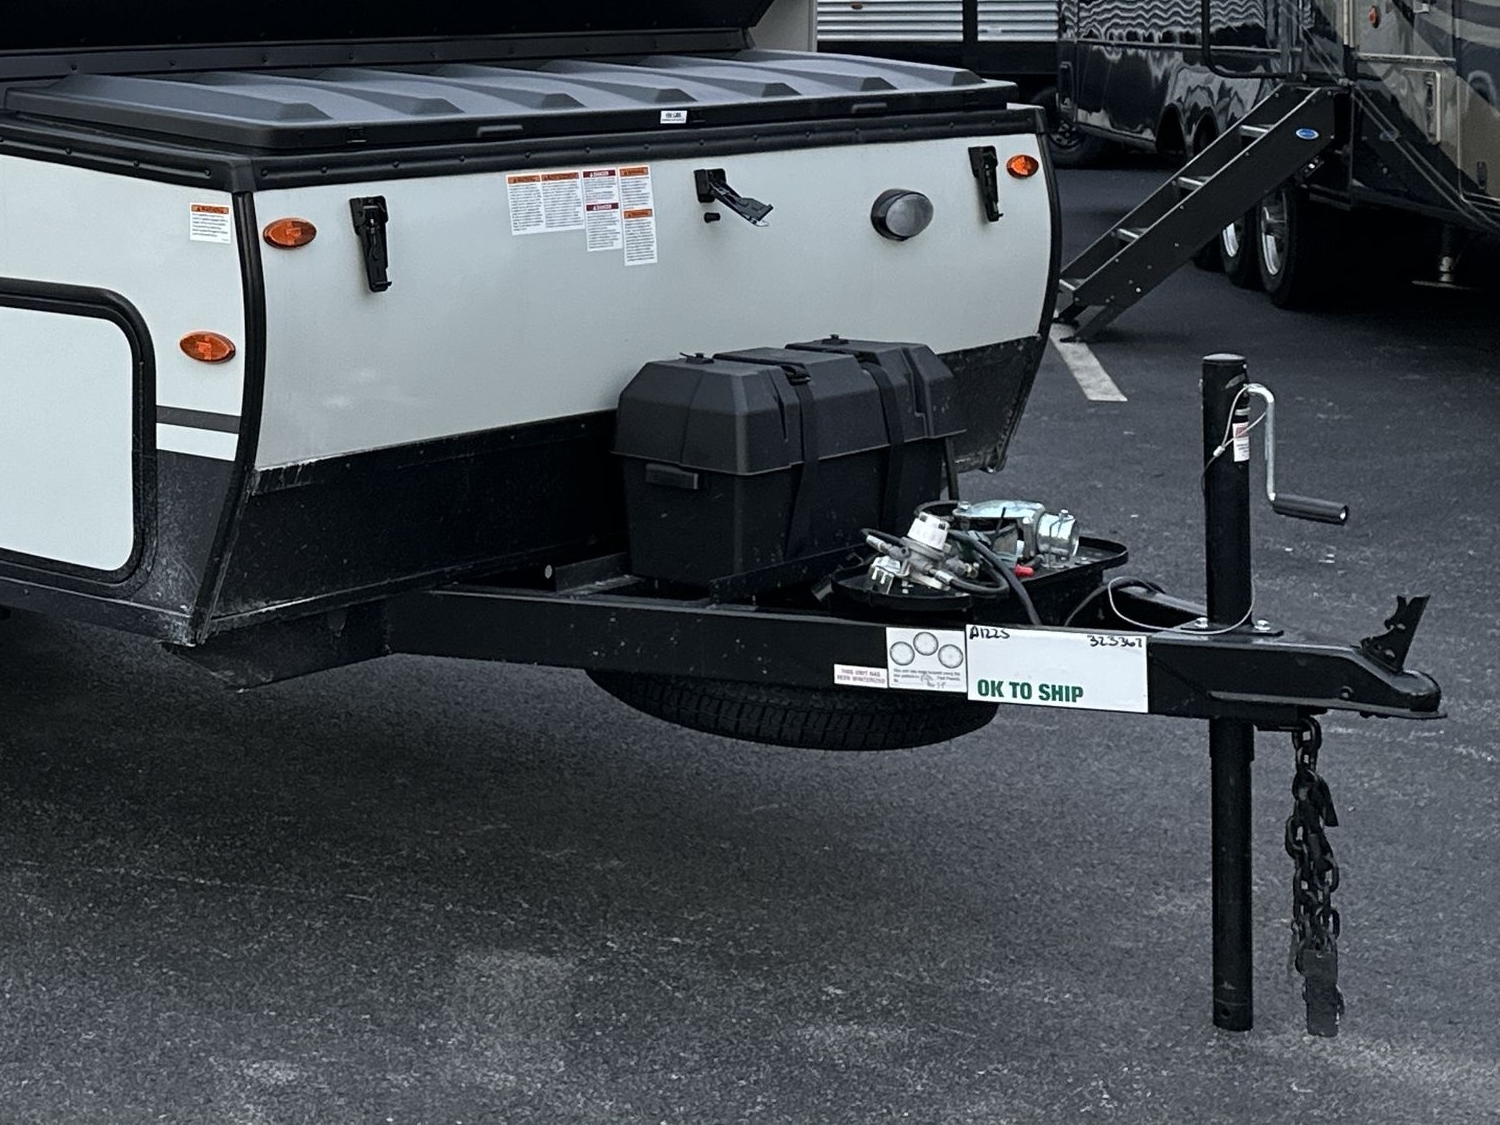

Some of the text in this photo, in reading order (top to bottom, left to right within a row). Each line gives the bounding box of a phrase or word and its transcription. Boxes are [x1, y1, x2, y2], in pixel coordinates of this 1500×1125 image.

[977, 679, 1004, 698] OK
[1009, 681, 1033, 700] TO
[1038, 683, 1084, 703] SHIP
